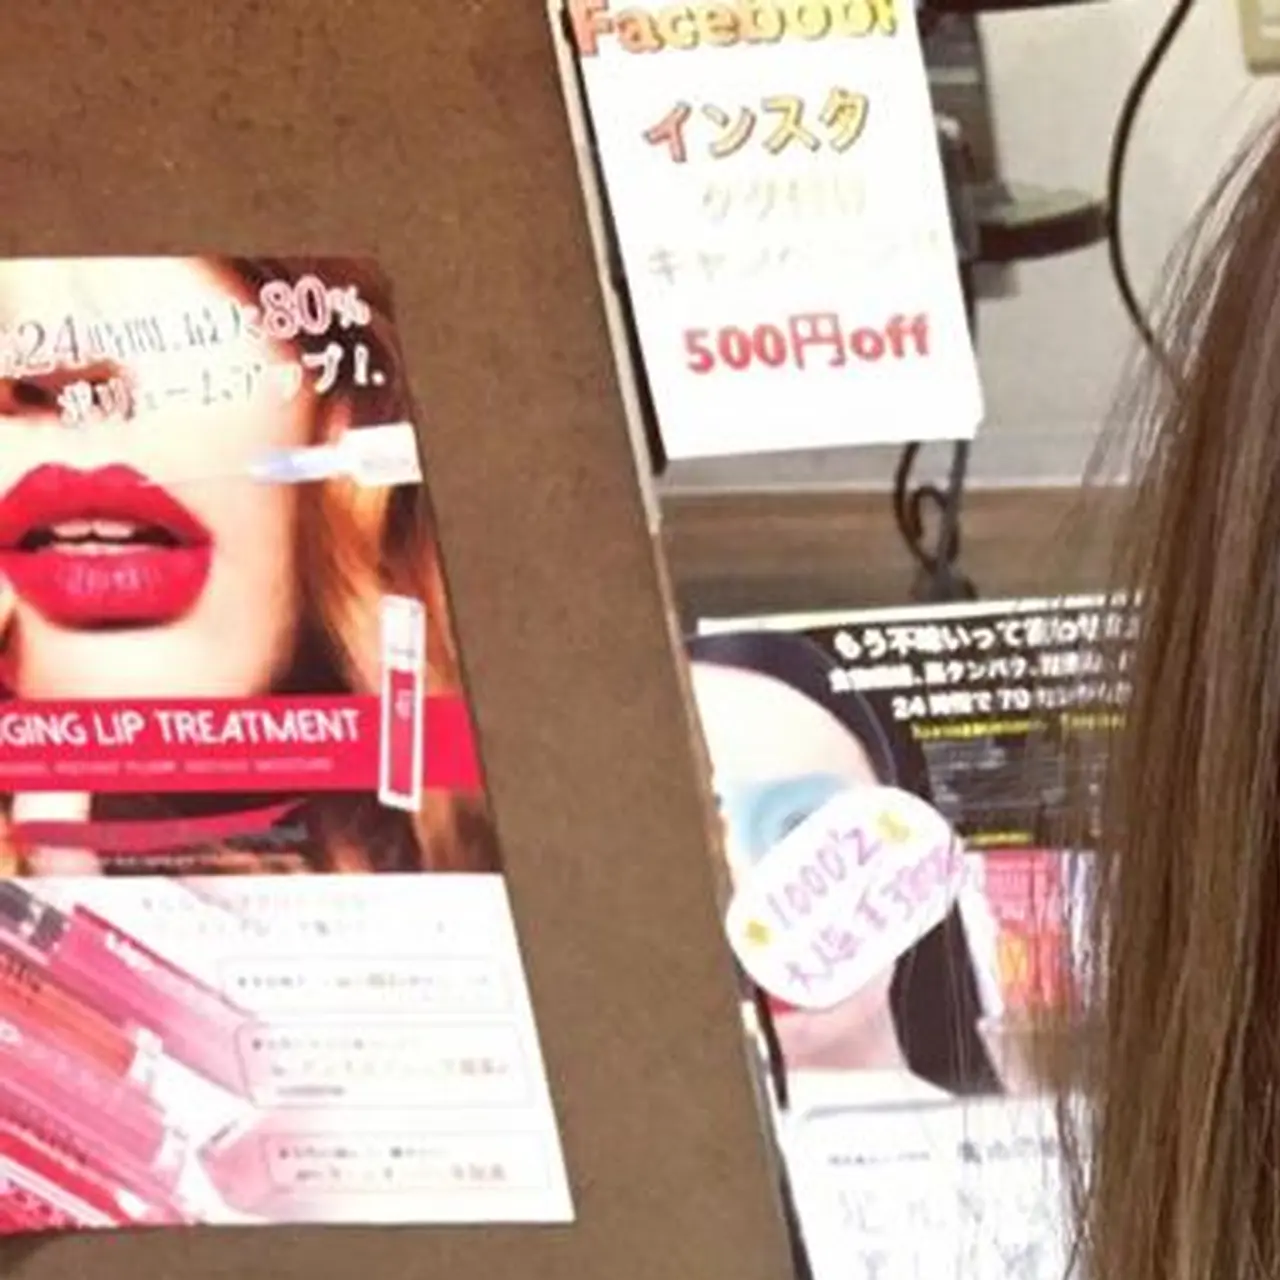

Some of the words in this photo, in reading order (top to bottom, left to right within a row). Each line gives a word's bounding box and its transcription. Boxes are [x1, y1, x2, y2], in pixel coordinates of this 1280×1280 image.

[642, 87, 871, 163] インスタ
[682, 311, 931, 375] 500円off
[94, 711, 145, 746] LIP
[153, 708, 360, 745] TREATMENT
